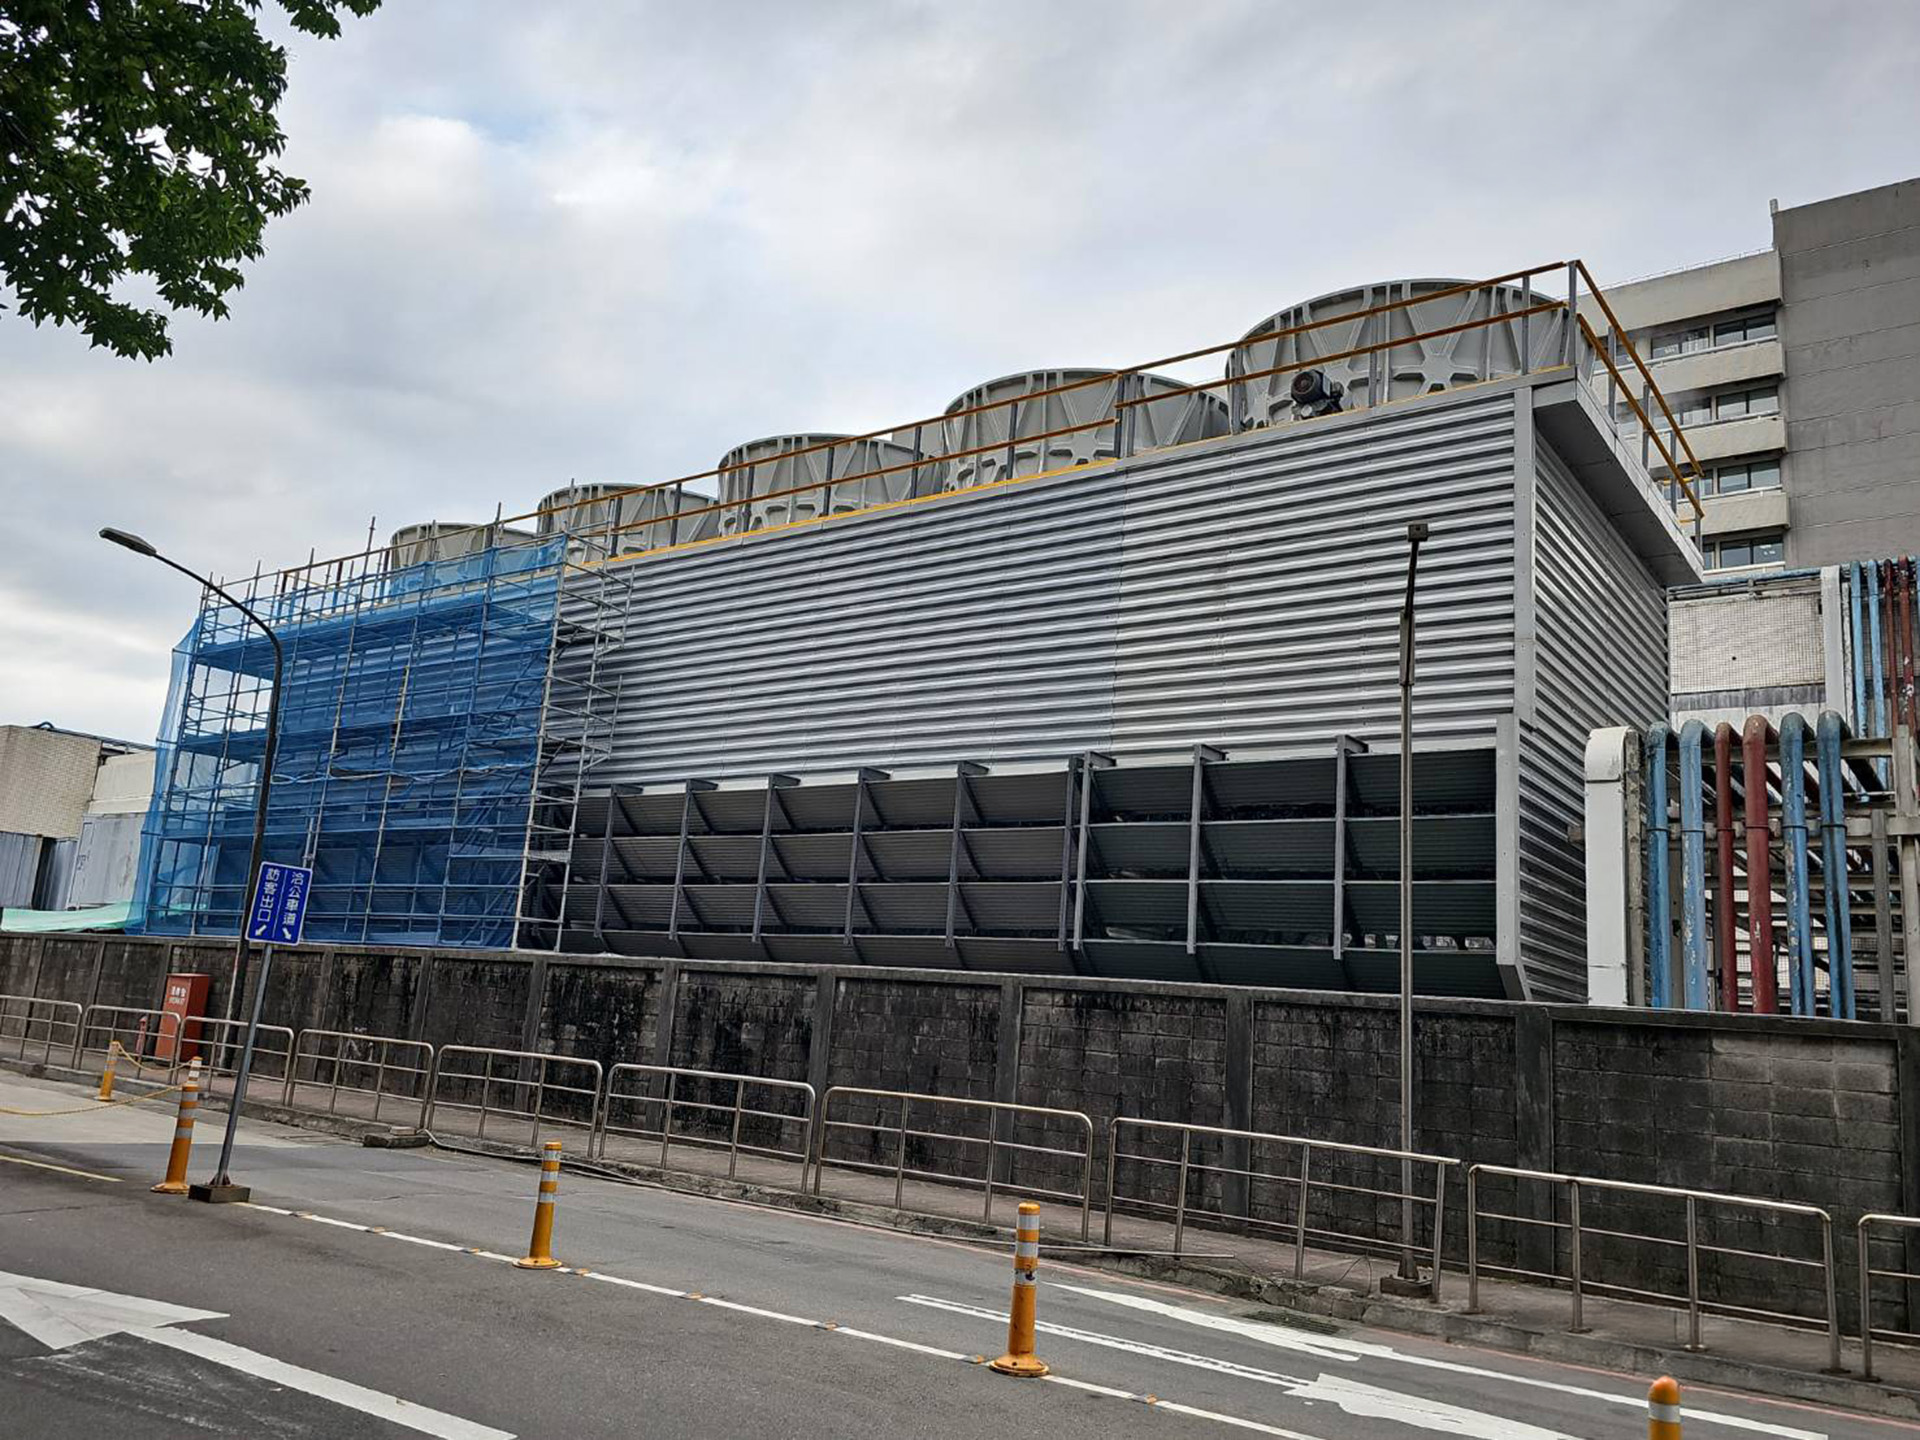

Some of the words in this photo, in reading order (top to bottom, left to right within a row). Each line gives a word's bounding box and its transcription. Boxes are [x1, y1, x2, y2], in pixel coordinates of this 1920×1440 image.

[257, 868, 280, 922] 訪客出口
[282, 871, 304, 925] 洽公車道
